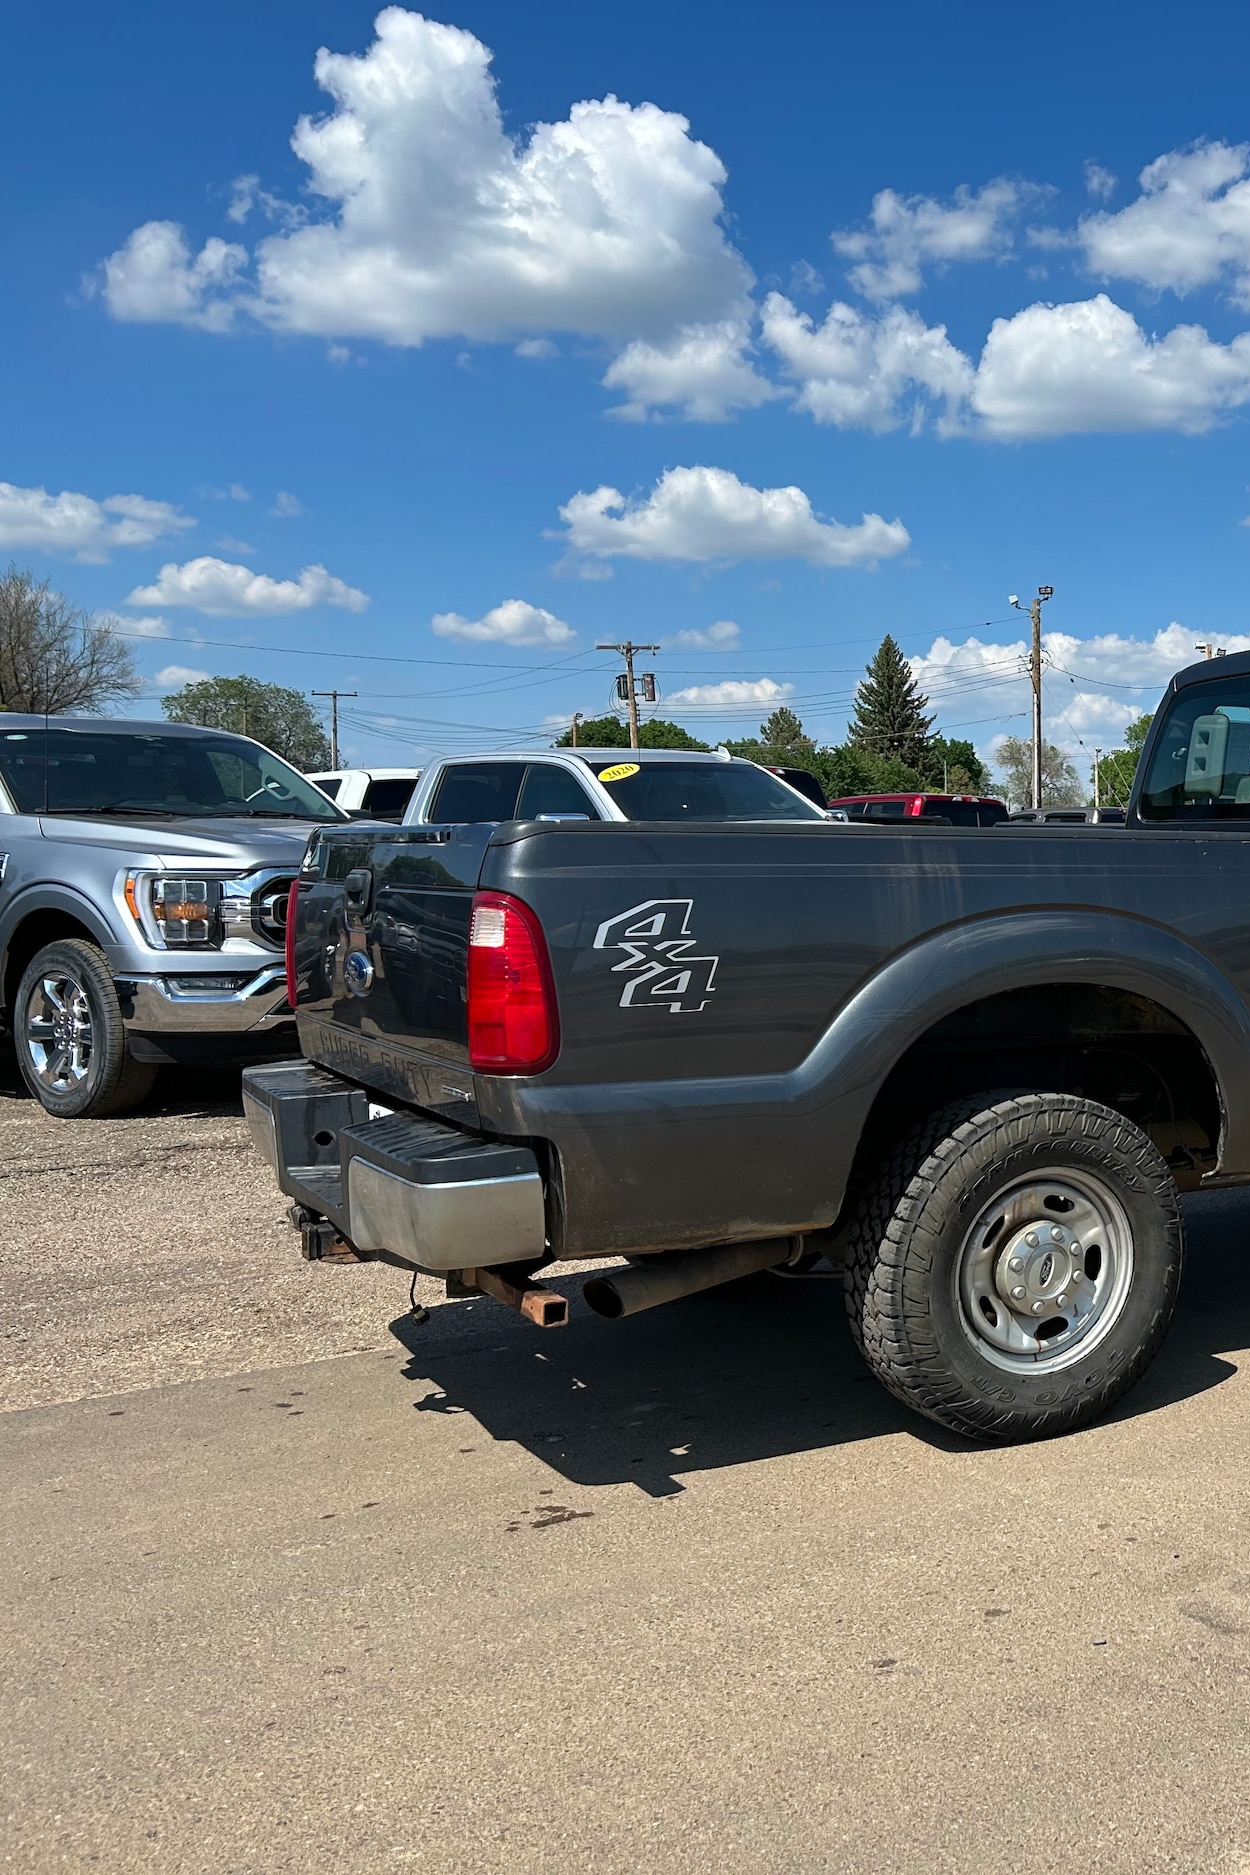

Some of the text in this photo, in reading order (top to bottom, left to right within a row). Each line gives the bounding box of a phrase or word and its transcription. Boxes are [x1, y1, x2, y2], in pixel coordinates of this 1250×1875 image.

[603, 764, 635, 780] 2020
[381, 1052, 439, 1102] DUTY
[1032, 1138, 1147, 1194] COUNTRY
[1034, 1349, 1126, 1406] TOYO
